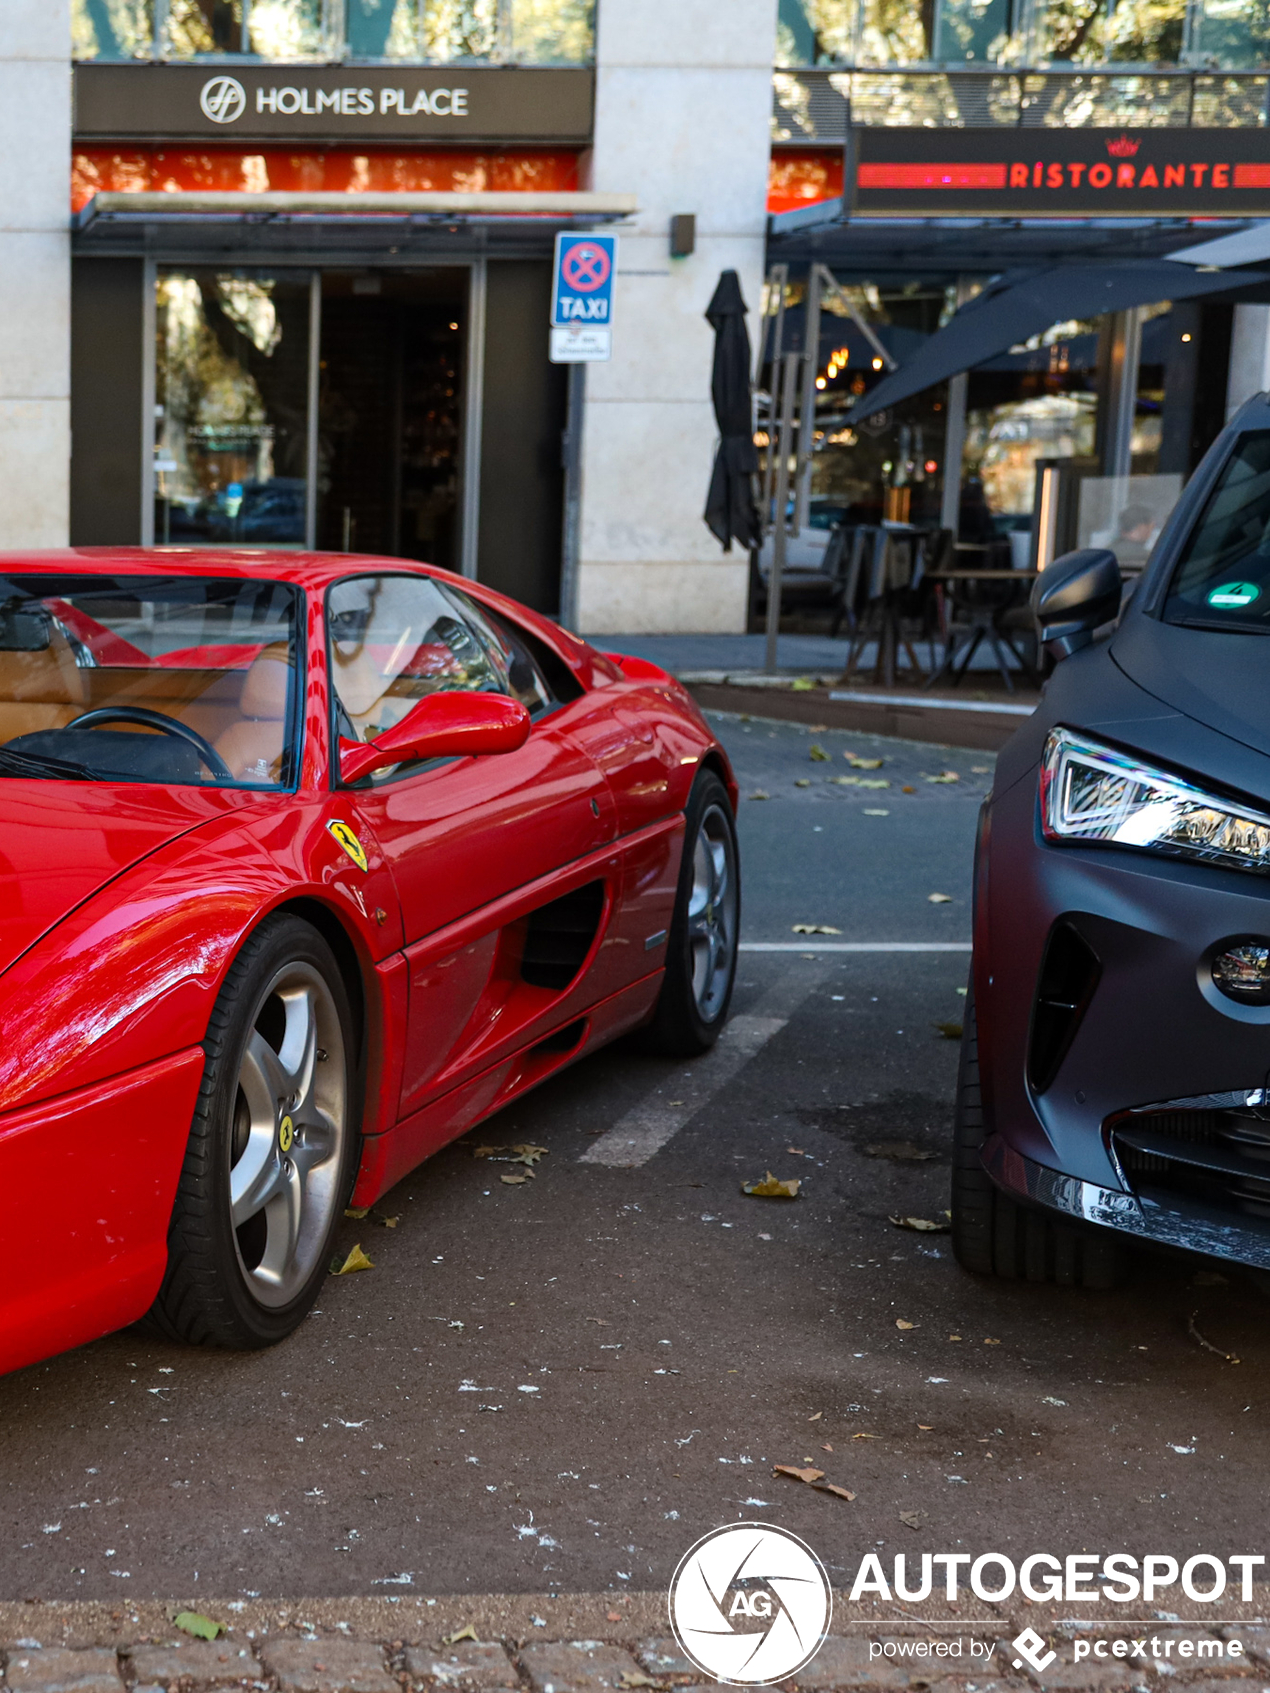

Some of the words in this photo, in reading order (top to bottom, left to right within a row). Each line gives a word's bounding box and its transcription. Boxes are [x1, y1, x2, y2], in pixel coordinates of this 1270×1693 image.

[256, 86, 375, 115] HOLMES
[380, 88, 469, 116] PLACE
[1009, 161, 1230, 189] RISTORANTE
[559, 296, 608, 319] TAXI
